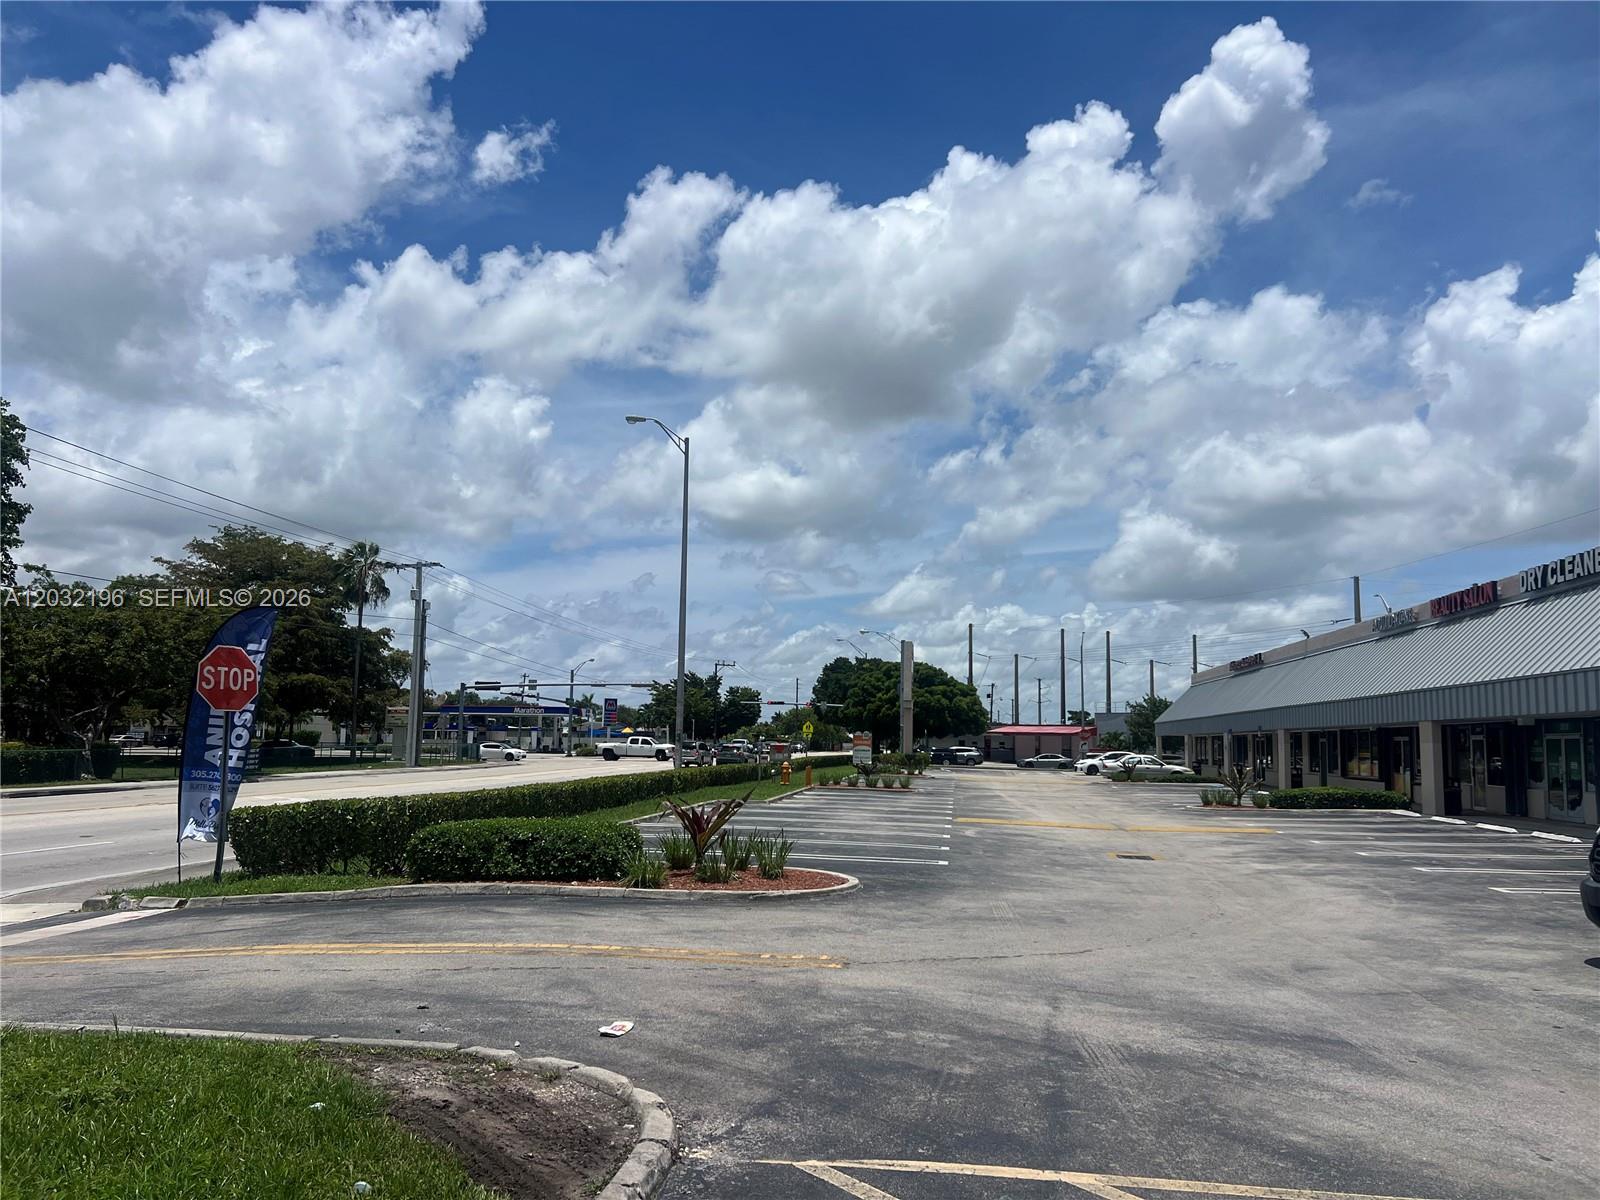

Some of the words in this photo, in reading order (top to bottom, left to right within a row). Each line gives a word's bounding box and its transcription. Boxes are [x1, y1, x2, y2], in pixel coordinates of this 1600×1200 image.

[1520, 565, 1544, 593] DRY
[1430, 591, 1463, 618] BEAUTY
[1464, 582, 1495, 609] SALON
[202, 665, 255, 691] STOP
[514, 706, 545, 714] Marathon
